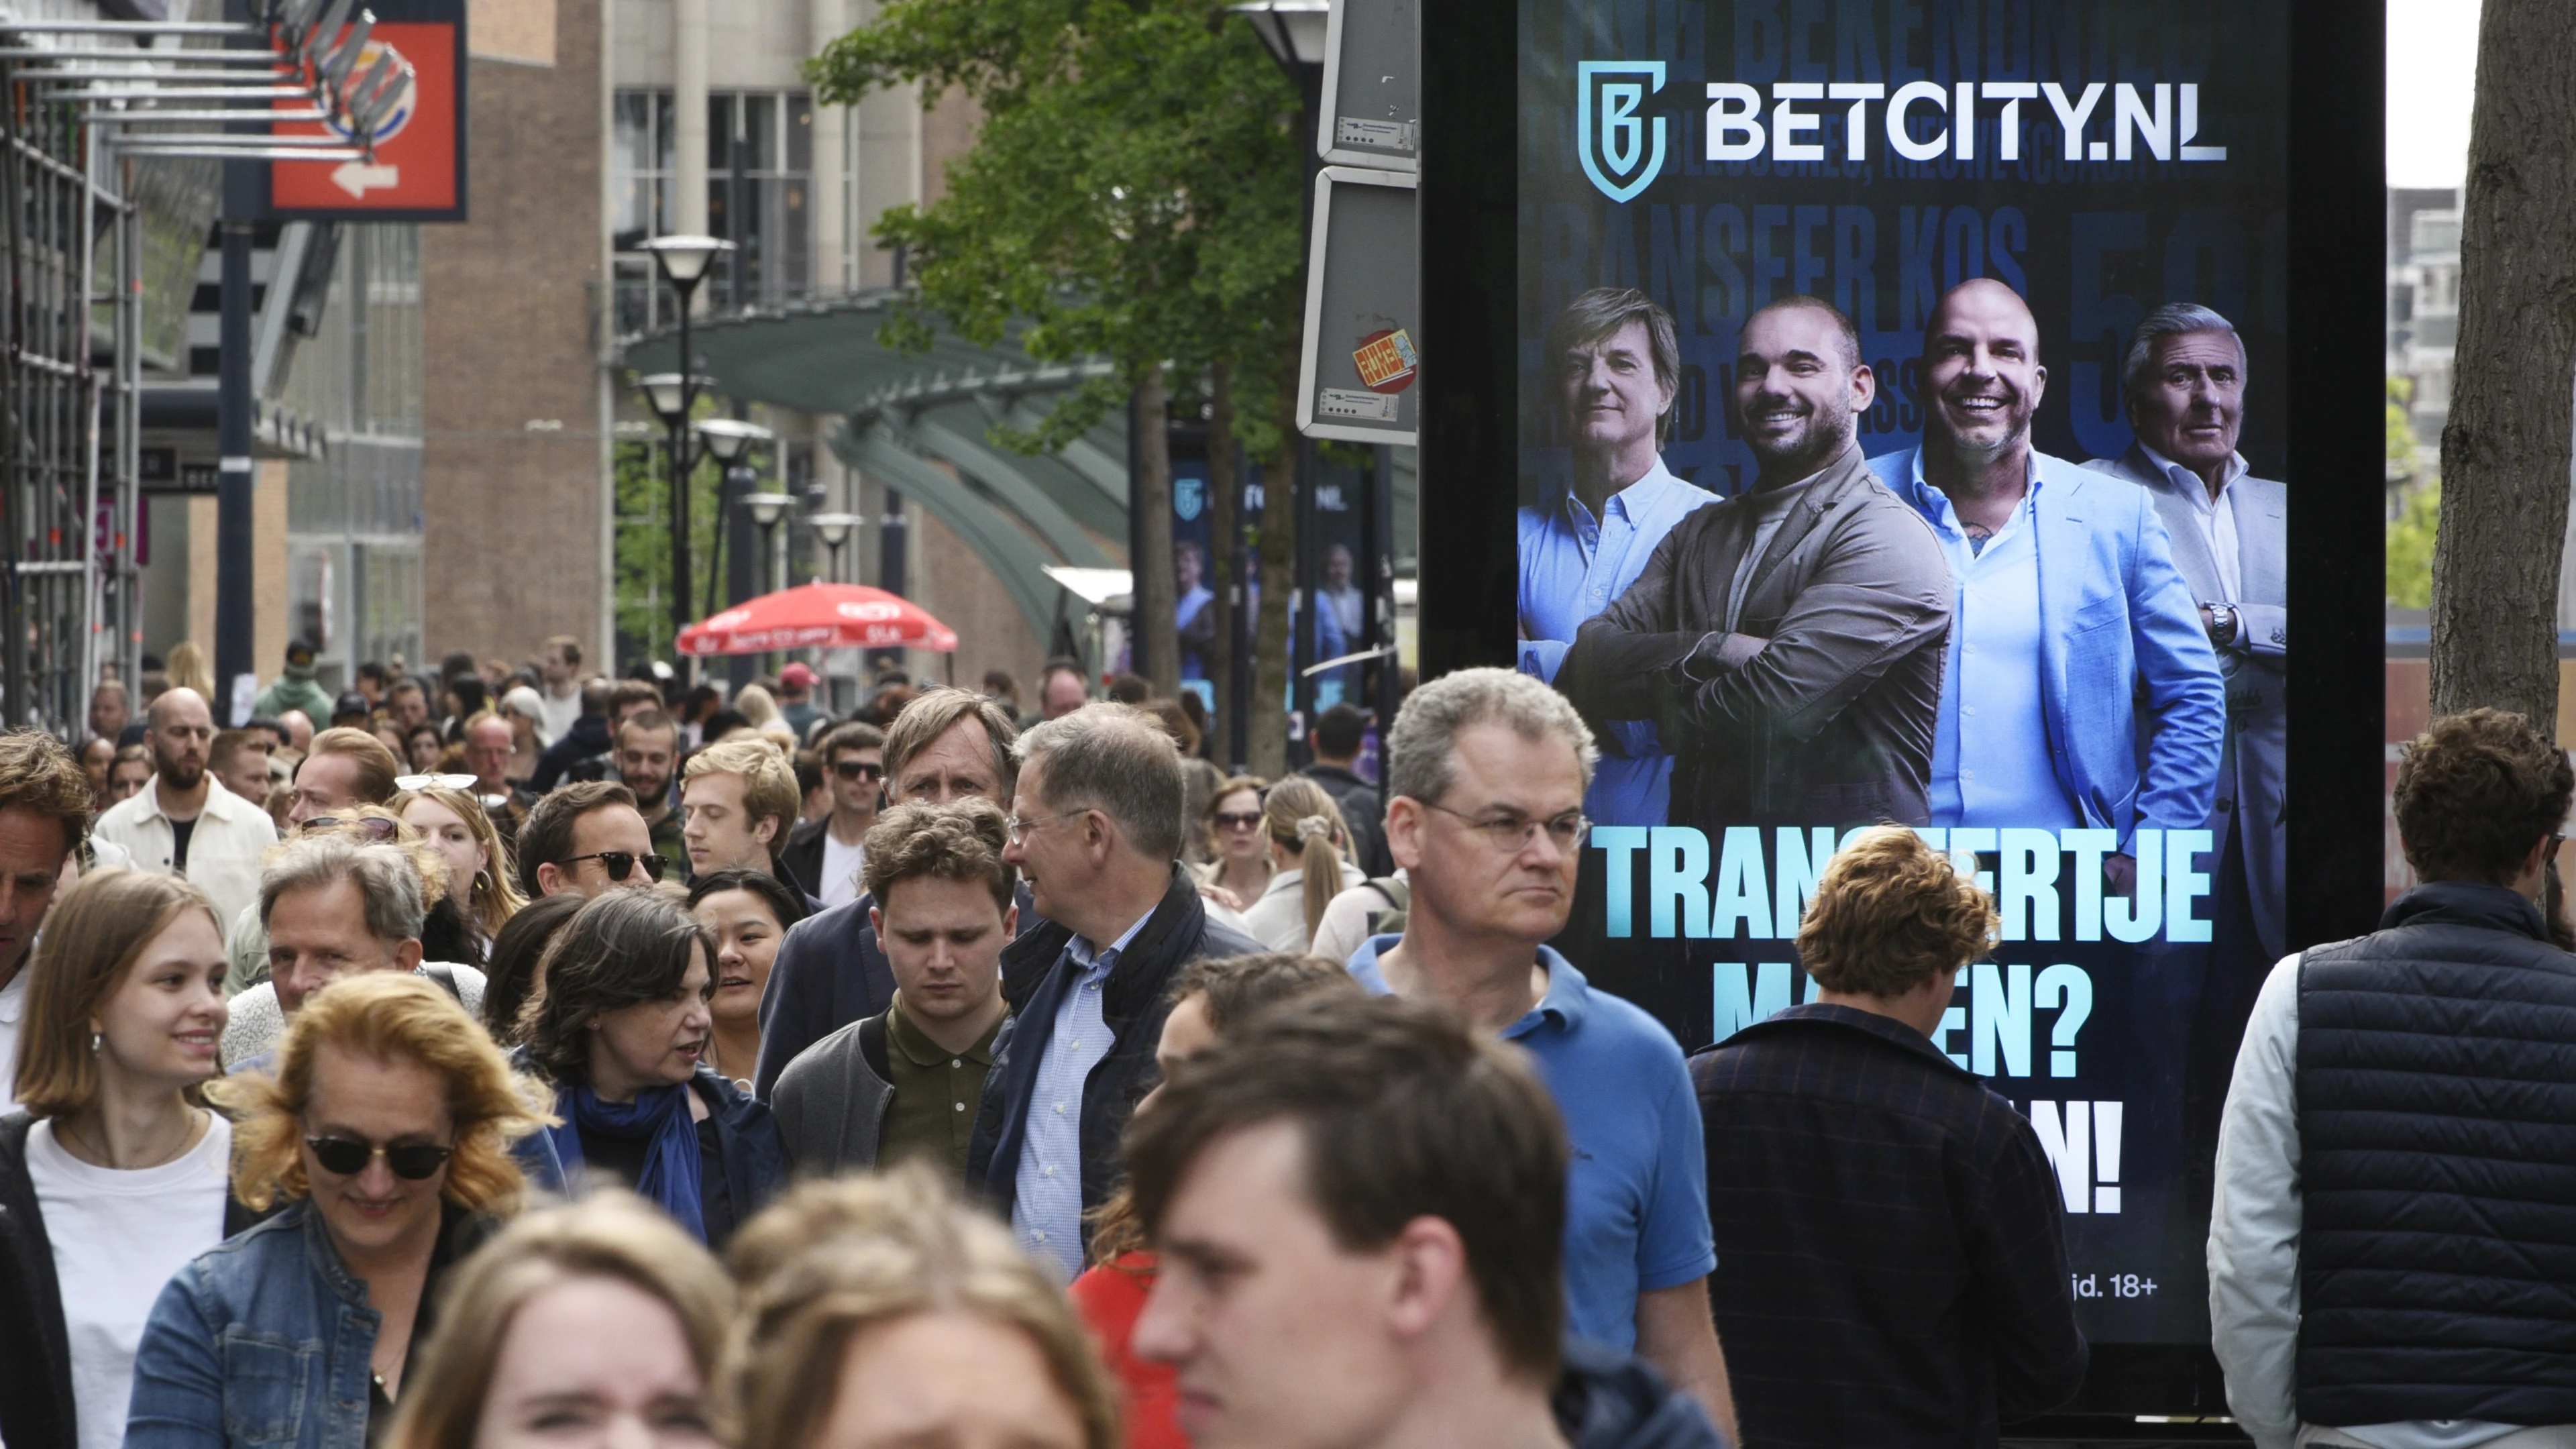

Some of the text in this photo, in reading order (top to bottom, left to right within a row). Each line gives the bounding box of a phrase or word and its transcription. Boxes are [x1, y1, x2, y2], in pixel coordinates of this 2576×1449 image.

[1705, 80, 2227, 162] BETCITY.NL
[1591, 825, 2214, 943] TRANERTJE
[1713, 962, 2093, 1078] MEN?
[2008, 1099, 2124, 1214] N!
[2072, 1273, 2158, 1302] jd. 18+
